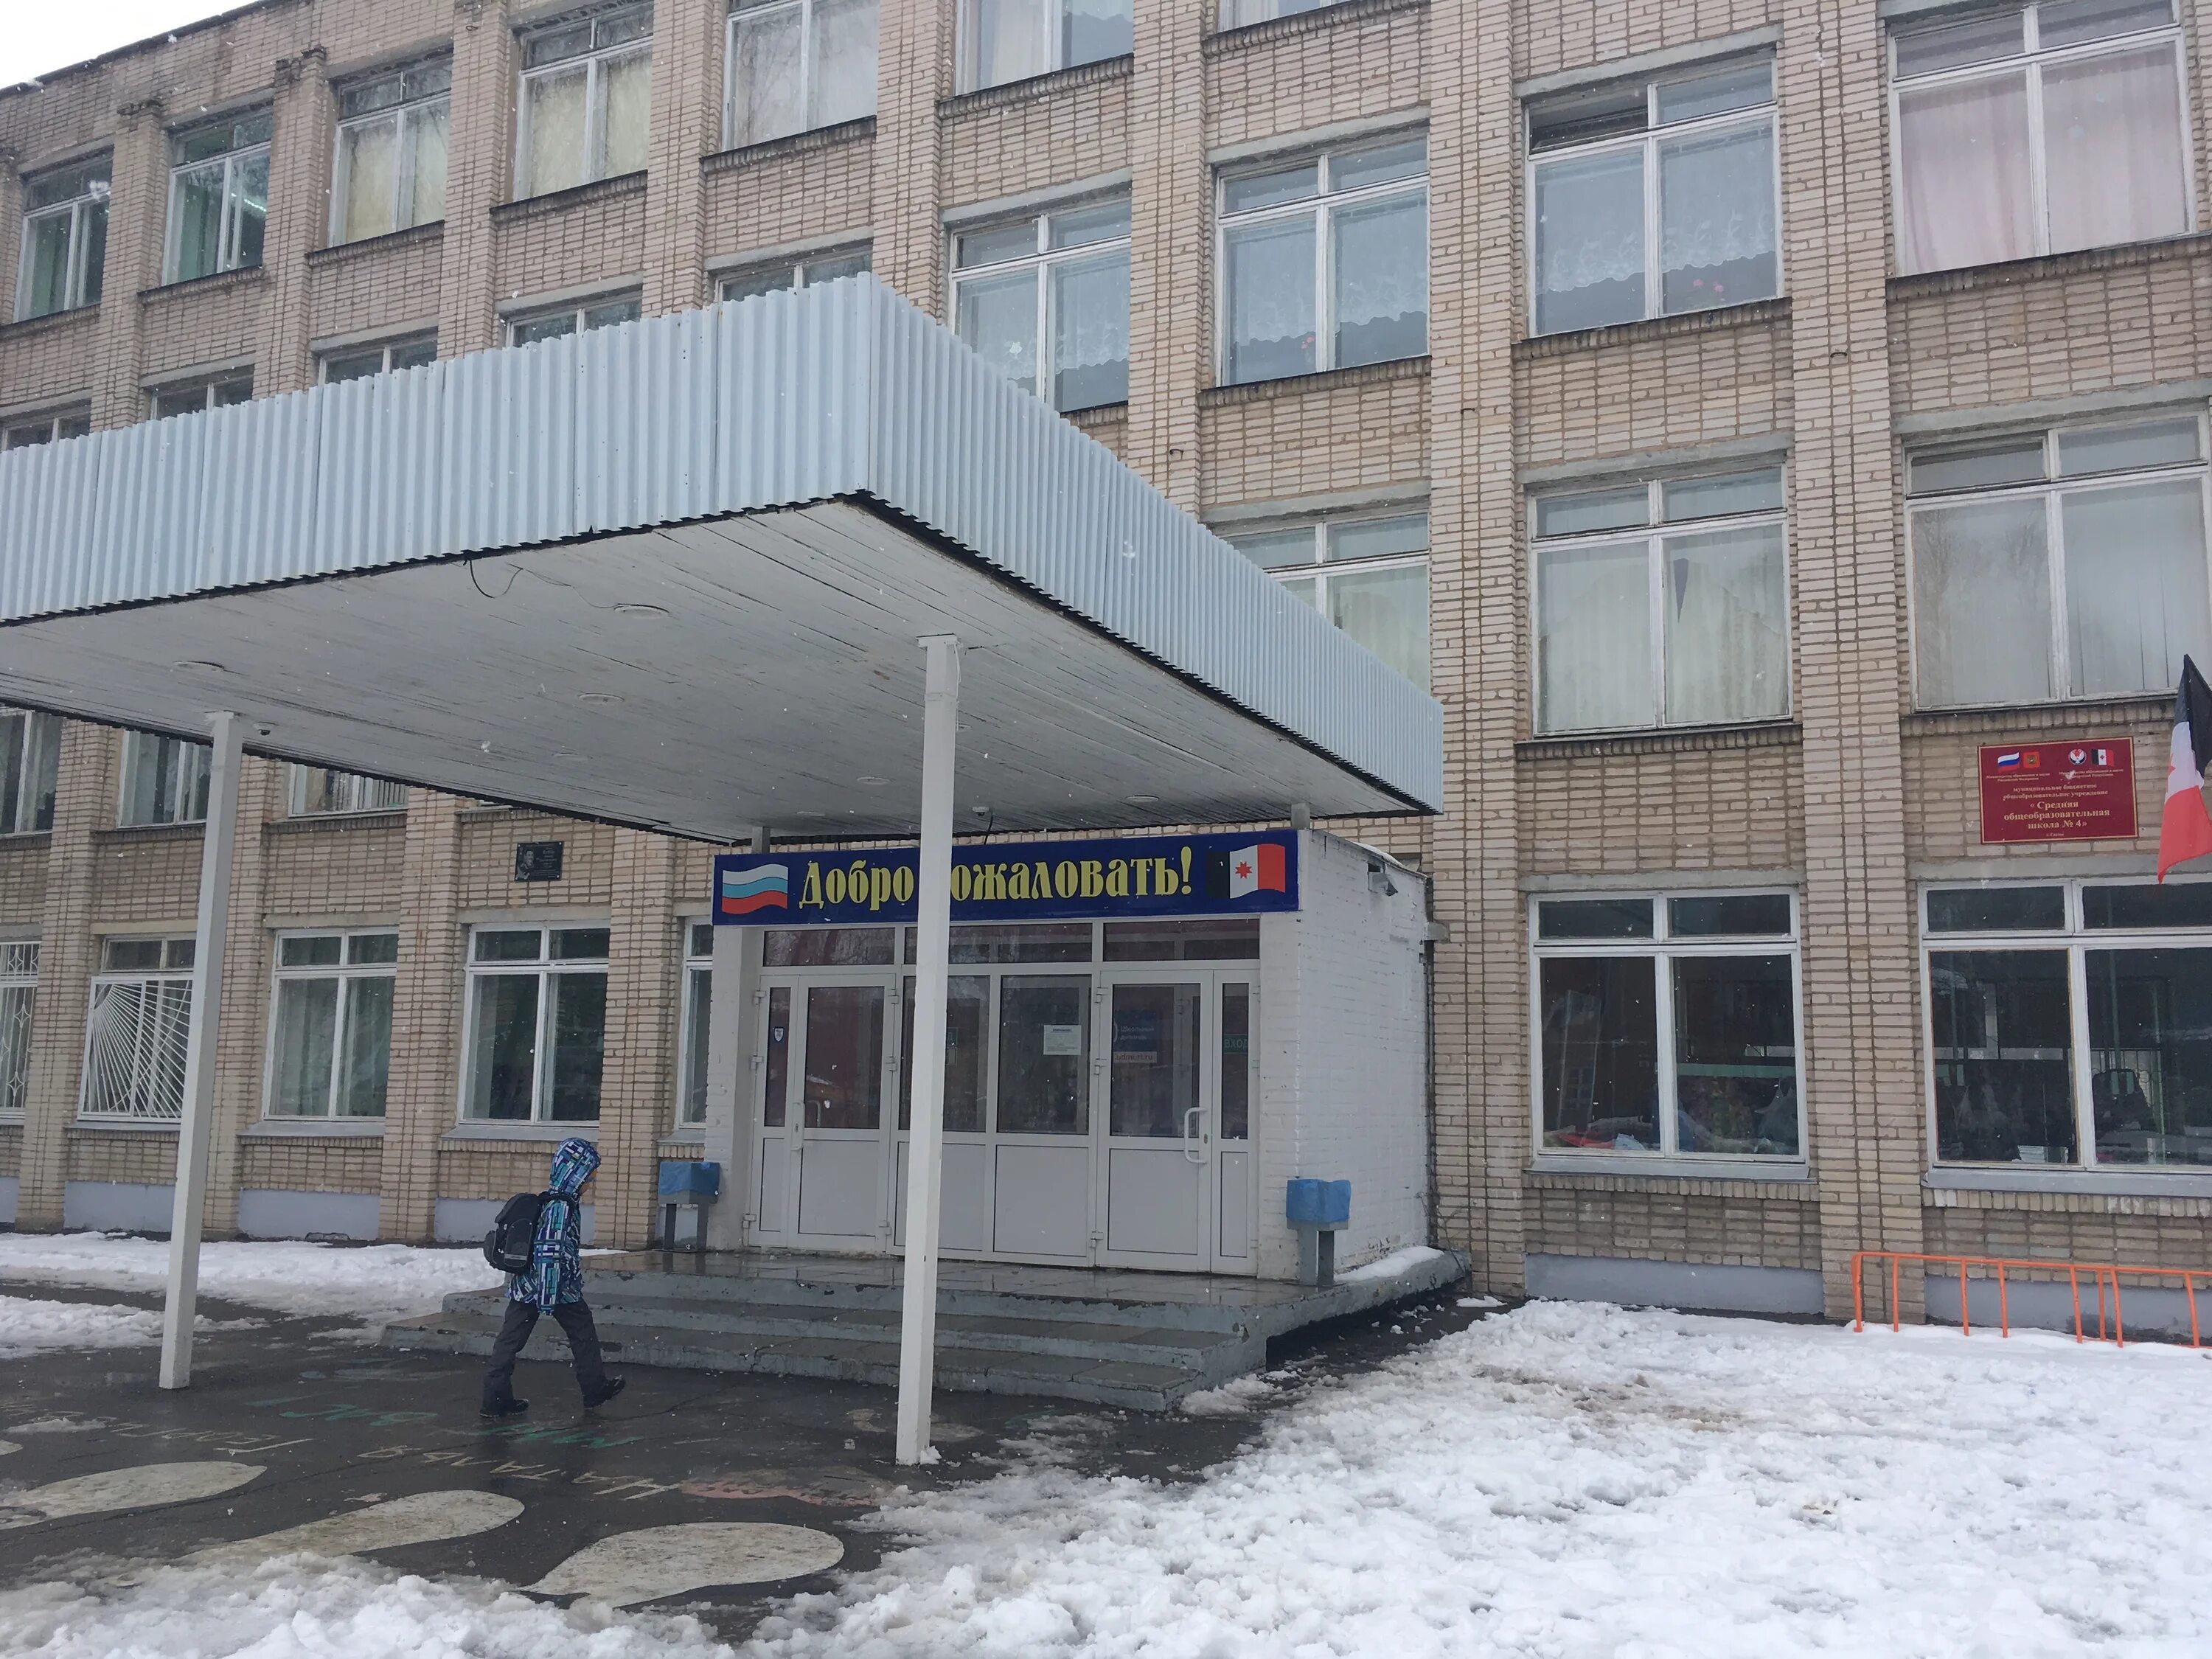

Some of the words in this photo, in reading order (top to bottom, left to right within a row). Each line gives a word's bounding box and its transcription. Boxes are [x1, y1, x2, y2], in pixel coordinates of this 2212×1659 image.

[2003, 809, 2110, 821] общеобразовательная
[799, 859, 914, 911] Добро
[950, 846, 1192, 901] ожаловать!
